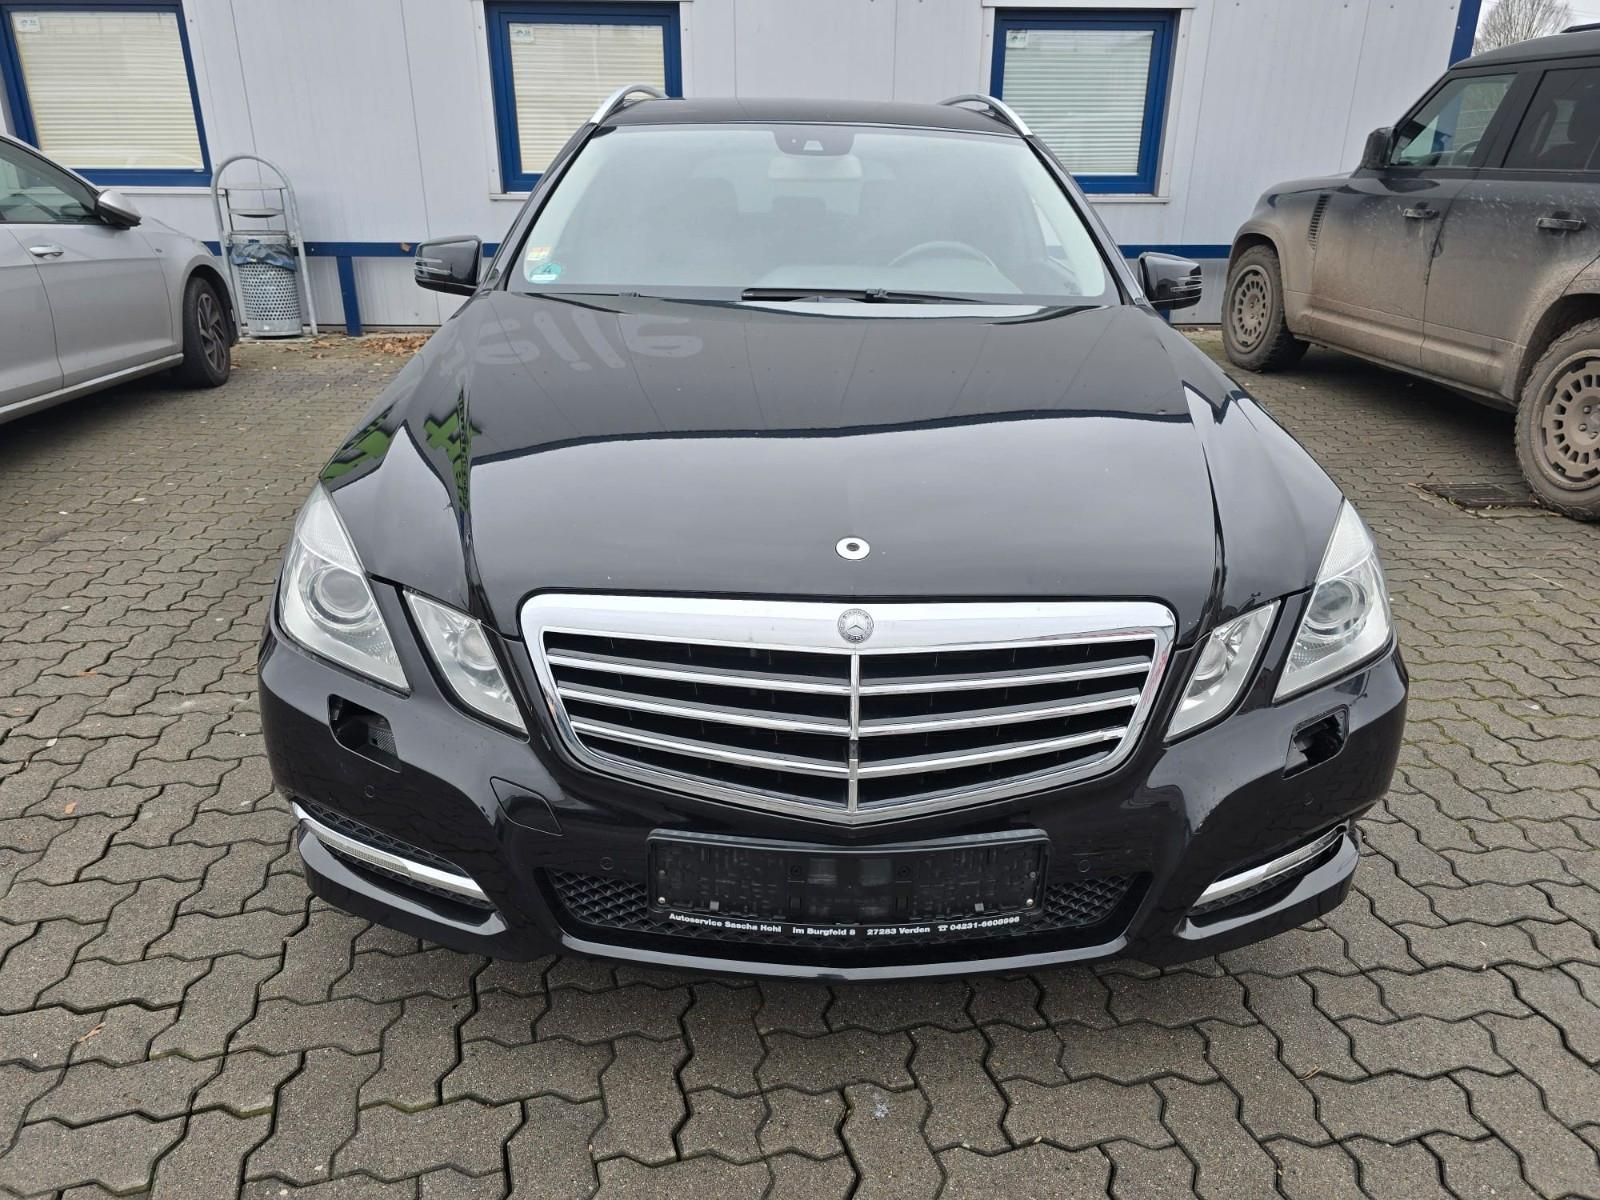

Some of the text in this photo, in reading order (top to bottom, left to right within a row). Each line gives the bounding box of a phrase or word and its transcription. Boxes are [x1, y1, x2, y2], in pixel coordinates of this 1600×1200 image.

[669, 912, 723, 927] Autoservice
[724, 921, 758, 931] Sascha
[760, 924, 782, 933] Hohl
[807, 927, 847, 936] Burgfeld
[899, 926, 931, 935] Verden
